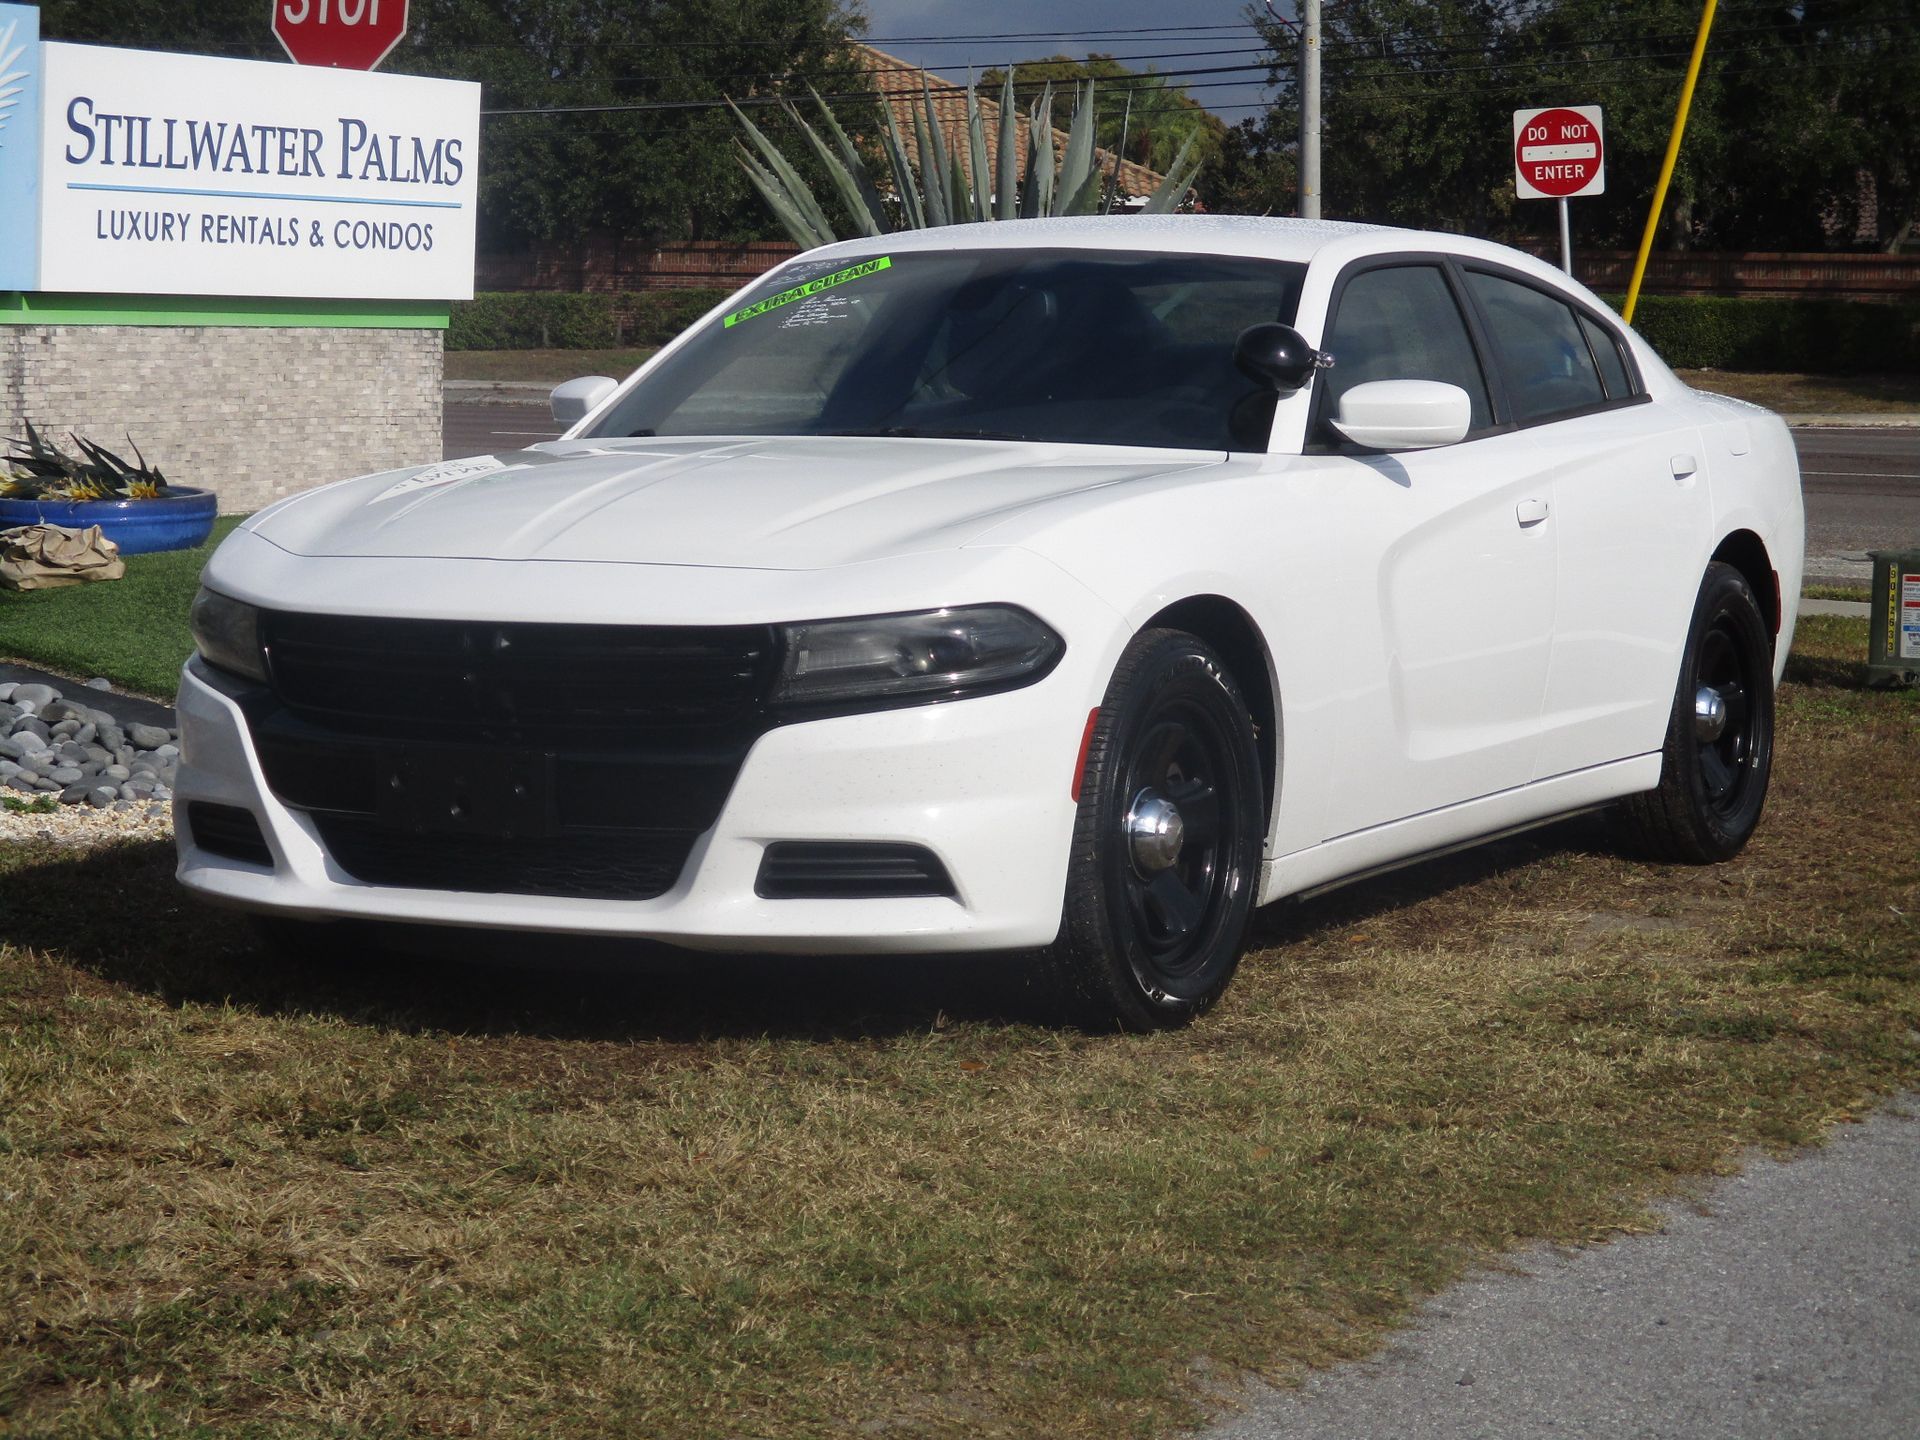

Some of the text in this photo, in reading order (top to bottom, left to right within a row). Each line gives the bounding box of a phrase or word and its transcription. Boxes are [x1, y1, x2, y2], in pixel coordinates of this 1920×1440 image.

[65, 96, 463, 186] STILLWATER PALMS
[1528, 125, 1589, 141] DO NOT
[1535, 165, 1584, 180] ENTER
[97, 209, 434, 251] LUXURY RENTALS & CONDOS
[734, 287, 807, 323] EXTRA
